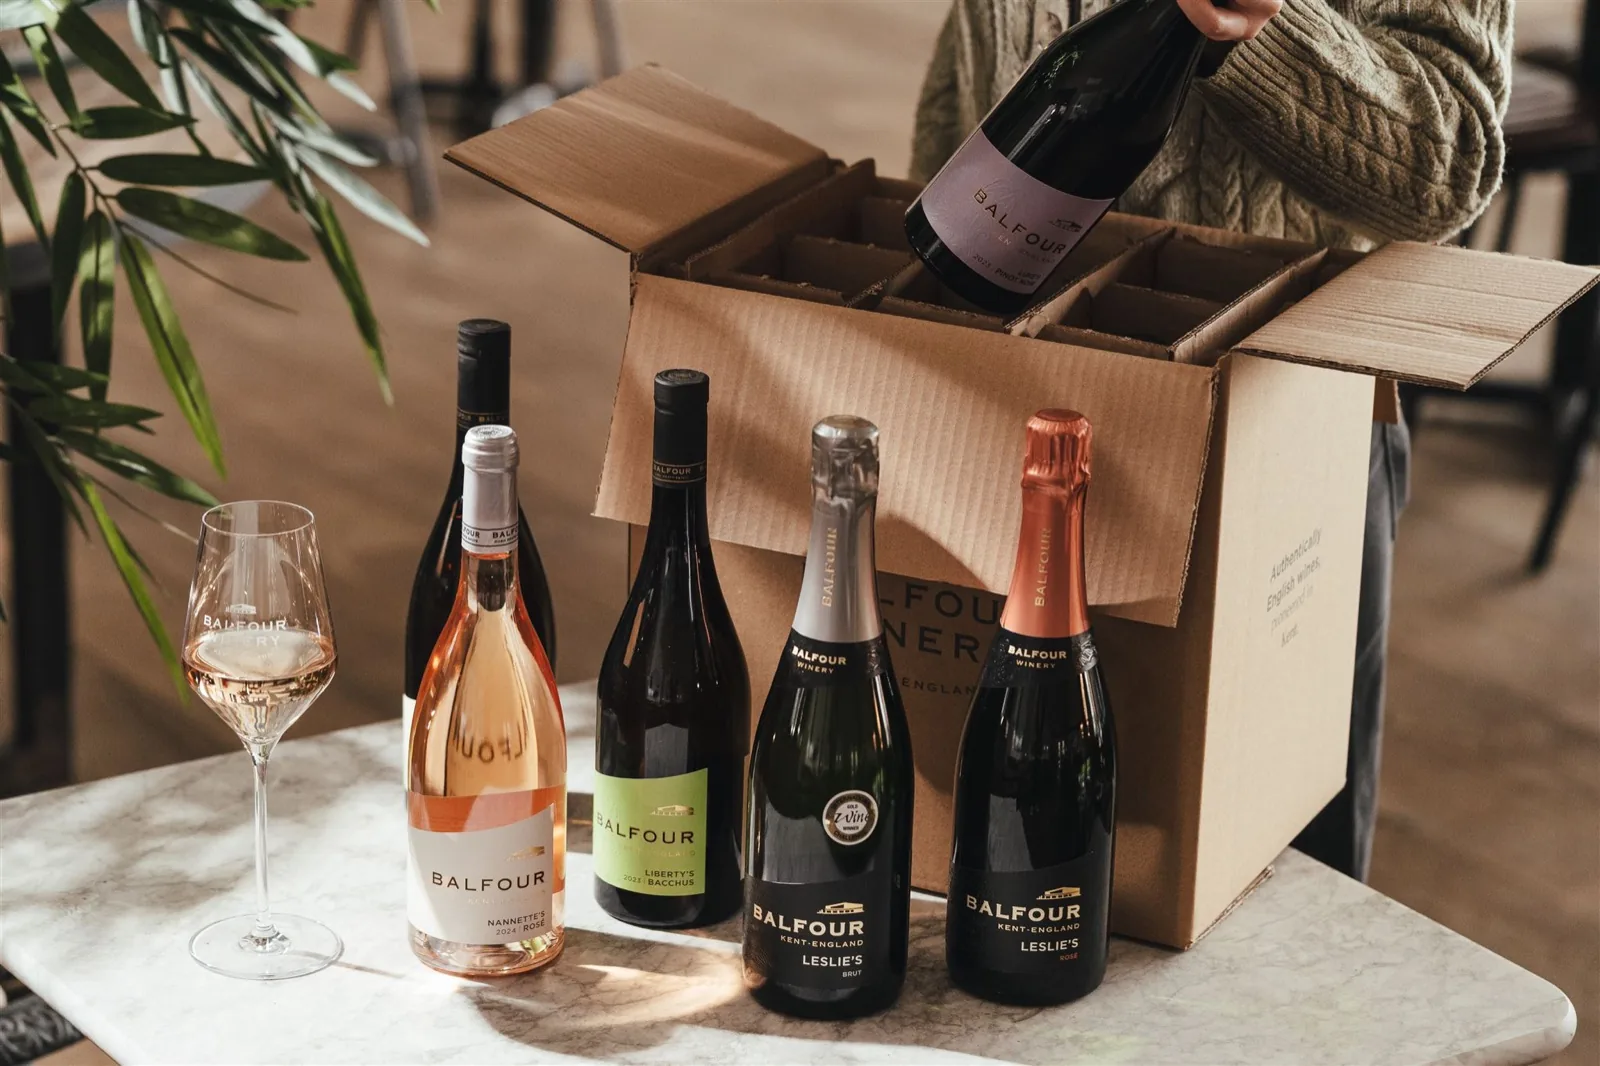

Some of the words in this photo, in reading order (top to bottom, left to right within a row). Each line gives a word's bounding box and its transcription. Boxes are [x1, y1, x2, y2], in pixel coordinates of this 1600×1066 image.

[972, 188, 1067, 255] BALFOUR
[1268, 527, 1322, 584] Authentically
[821, 527, 838, 608] BALFOUR
[1034, 527, 1052, 607] BALFOUR
[1266, 574, 1296, 612] English
[203, 614, 287, 632] BALFOUR
[883, 618, 980, 663] NER
[792, 645, 847, 665] BALFOUR
[1008, 644, 1067, 659] BALFOUR
[797, 661, 834, 674] WINERY
[1016, 659, 1056, 669] WINERY
[901, 677, 977, 696] ENGLAN
[596, 812, 694, 844] BALFOUR
[432, 871, 545, 892] BALFOUR
[623, 874, 641, 884] 2023
[647, 879, 695, 887] BACCHUS
[644, 869, 695, 877] LIBERTY'S
[966, 894, 1081, 922] BALFOUR
[487, 910, 545, 927] NANNETTE'S
[496, 927, 517, 936] 2024
[523, 918, 545, 932] ROSÉ
[753, 903, 864, 937] BALFOUR
[997, 922, 1080, 934] KENT-ENGLAND
[780, 934, 864, 948] KENT-ENGLAND
[1021, 938, 1079, 952] LESLIE'S
[802, 954, 863, 967] LESLIE'S
[842, 969, 862, 978] BRUT
